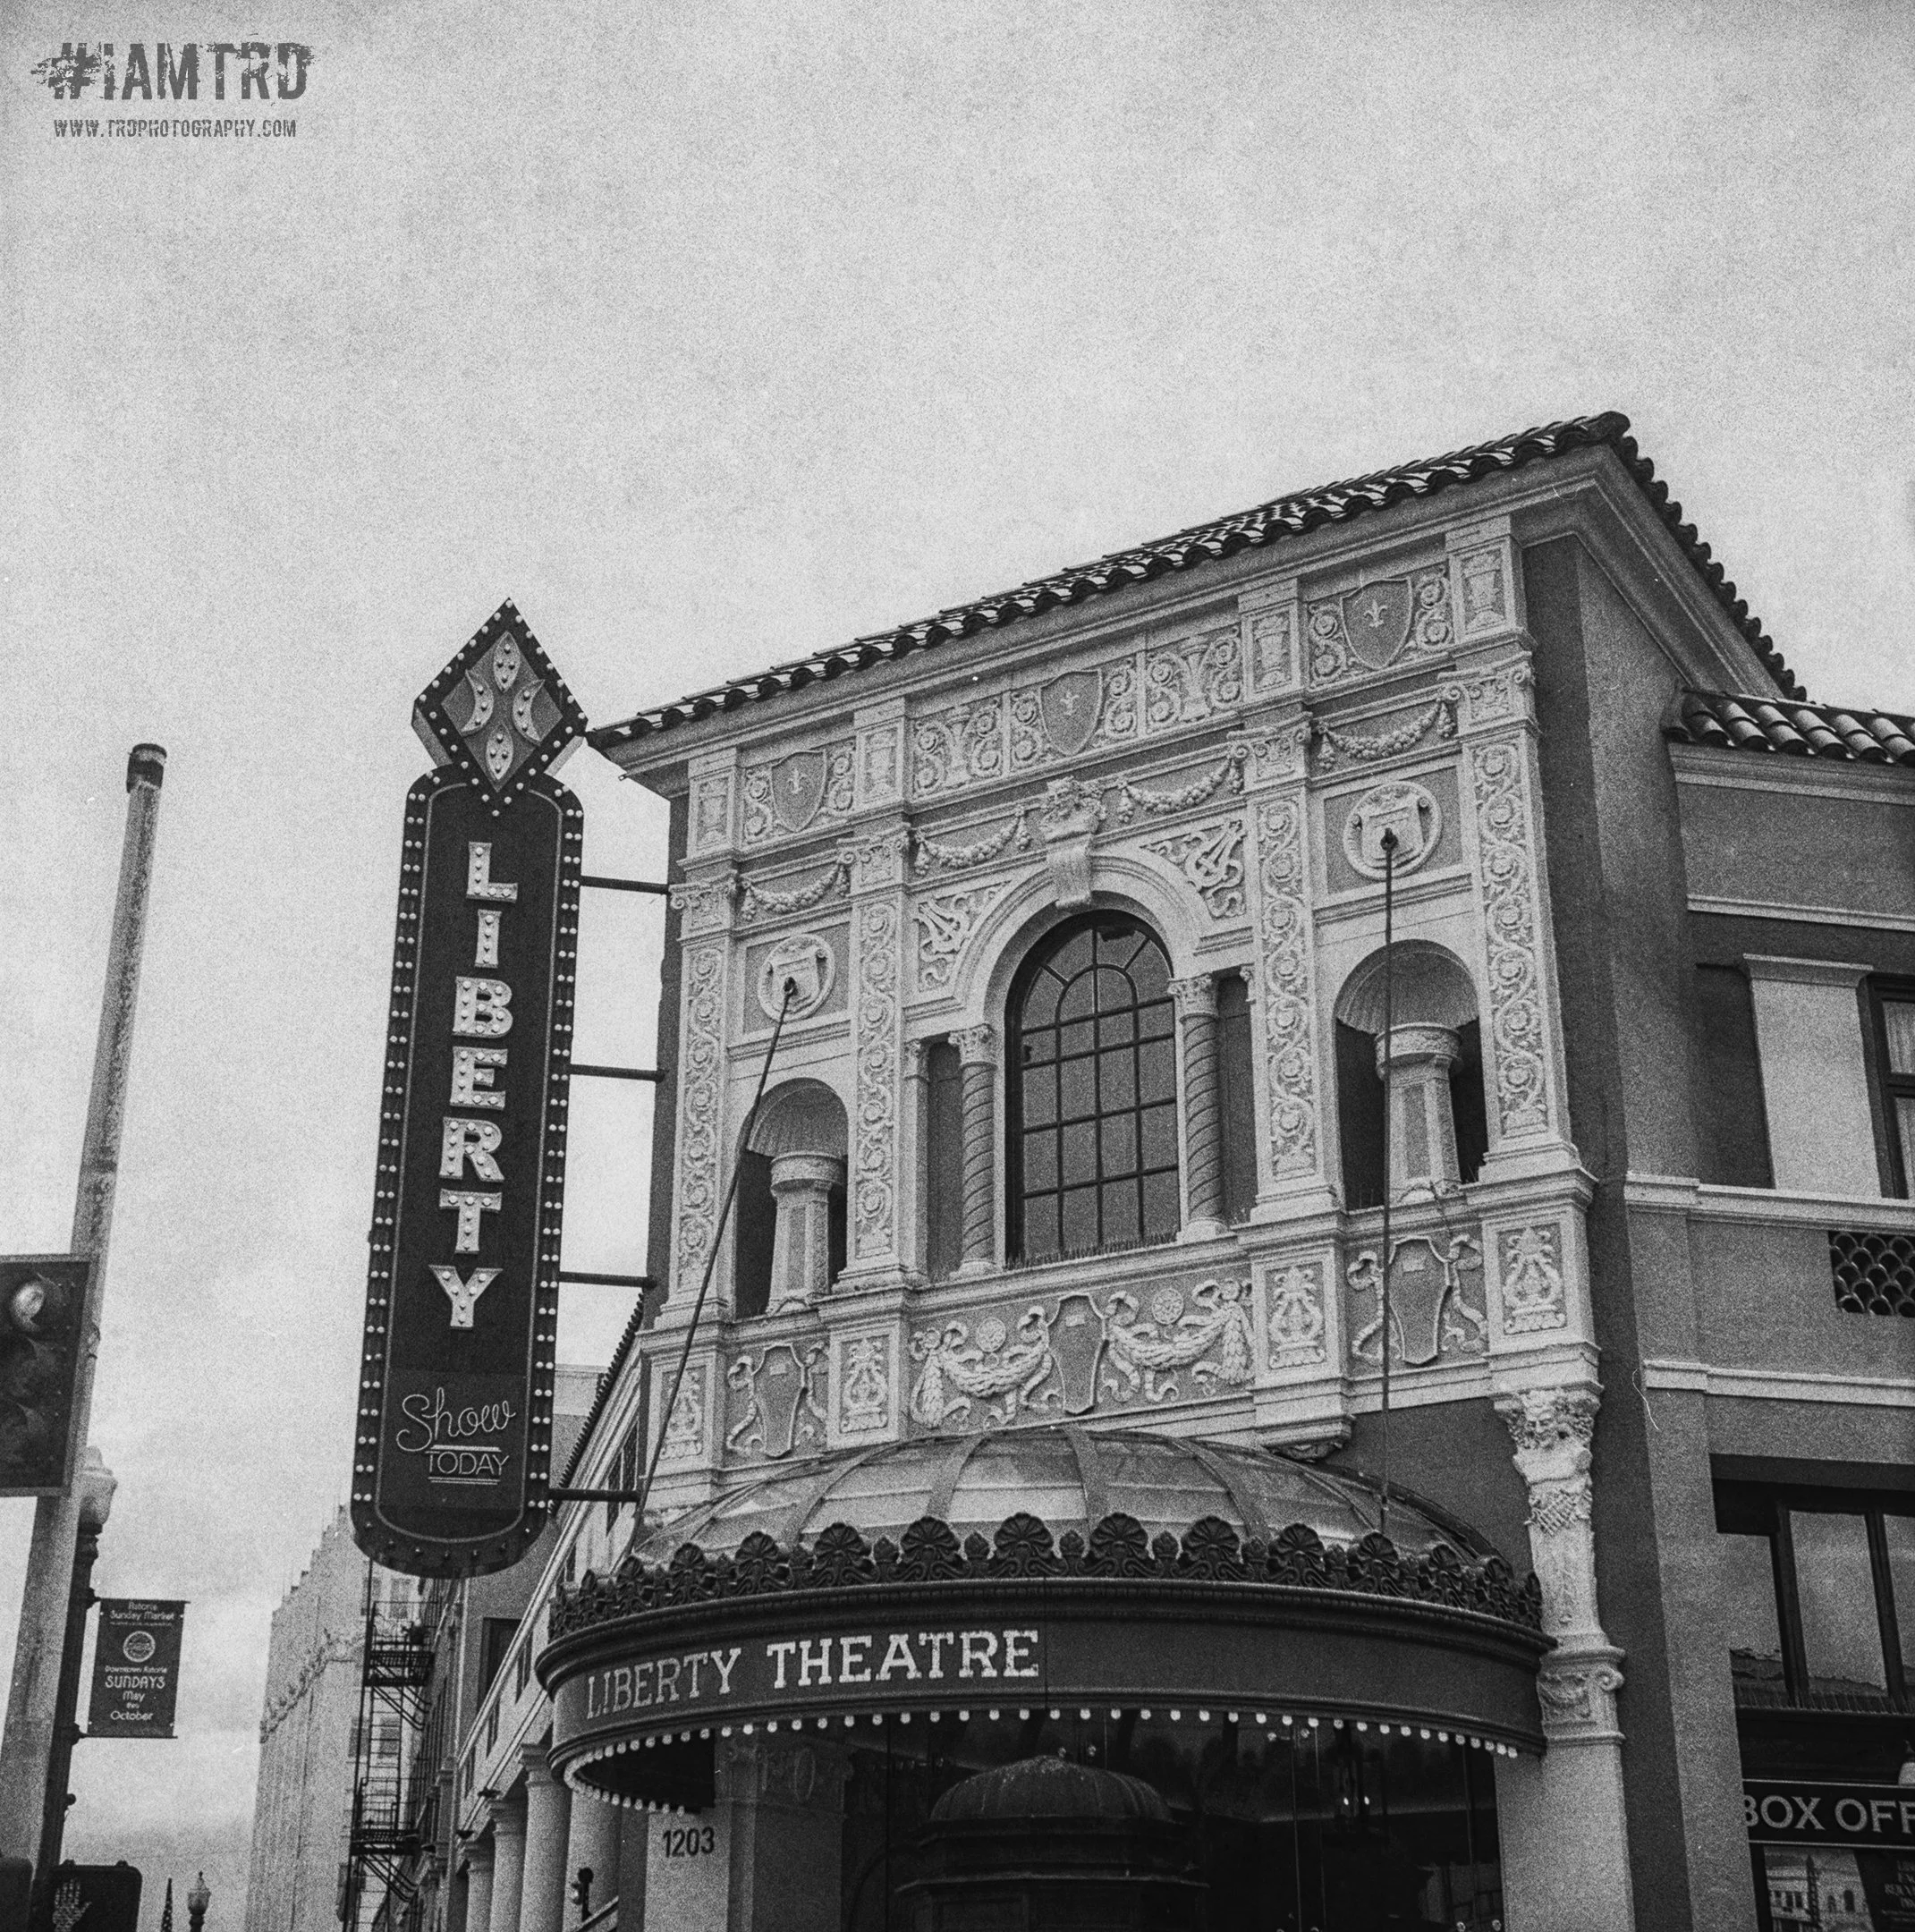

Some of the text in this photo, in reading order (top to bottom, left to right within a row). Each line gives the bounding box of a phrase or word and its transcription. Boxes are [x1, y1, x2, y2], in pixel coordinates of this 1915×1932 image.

[428, 842, 518, 1330] LIBERTY
[396, 1386, 516, 1452] Show
[425, 1451, 510, 1476] TODAY
[105, 1674, 165, 1689] SUNDAYS
[587, 1630, 1039, 1719] LIBERTY THEATRE
[123, 1690, 145, 1702] May
[110, 1710, 153, 1721] October
[1744, 1794, 1826, 1831] BOX
[663, 1826, 715, 1859] 1203
